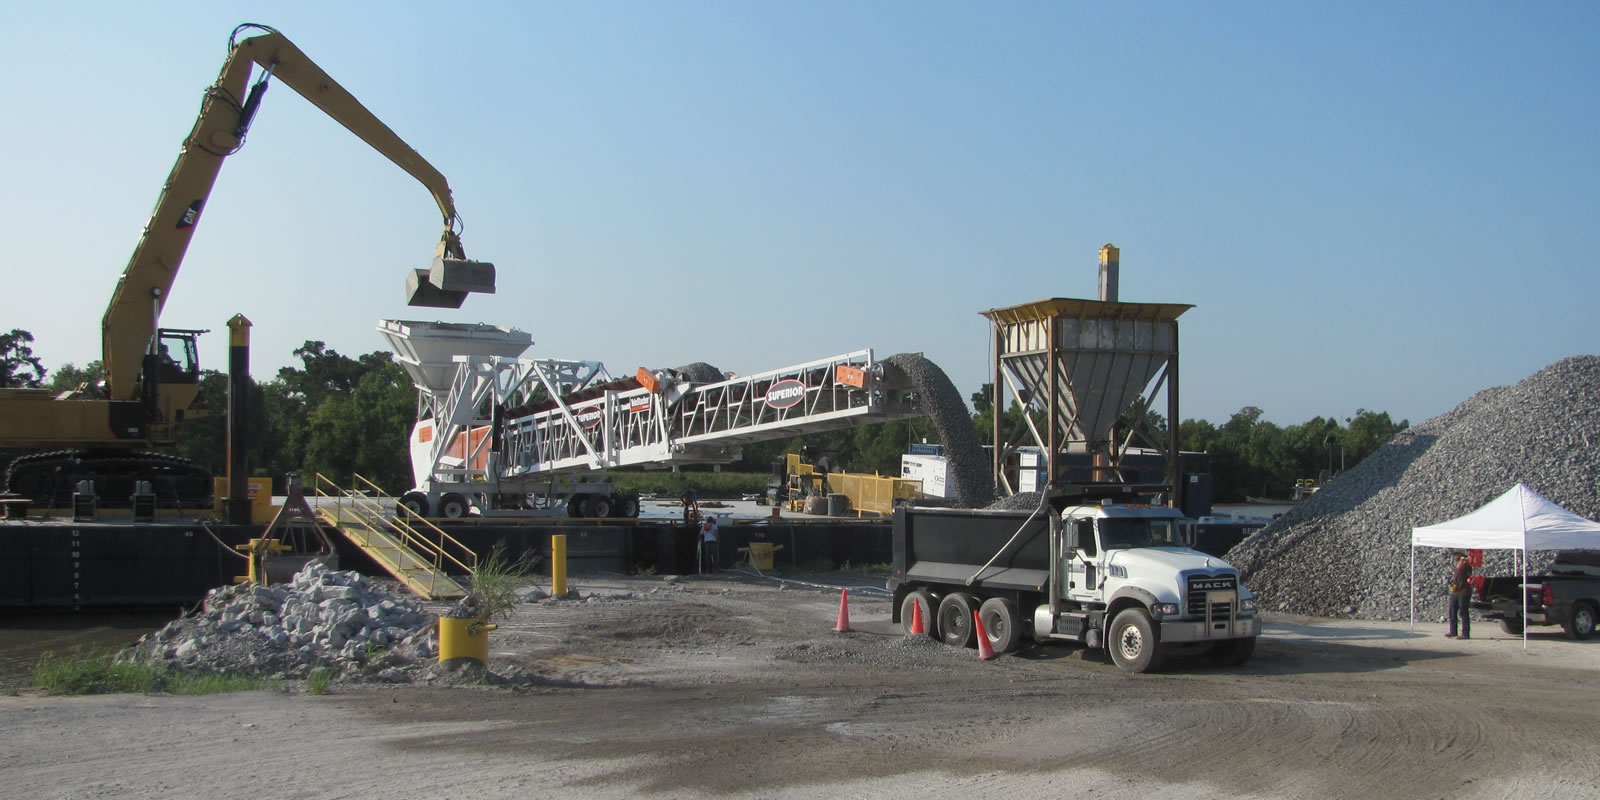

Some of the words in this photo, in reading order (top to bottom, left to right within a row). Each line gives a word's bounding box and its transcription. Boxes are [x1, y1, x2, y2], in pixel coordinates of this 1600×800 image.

[184, 207, 198, 225] CAT
[767, 386, 804, 402] SUPERIOR
[71, 529, 80, 537] 12
